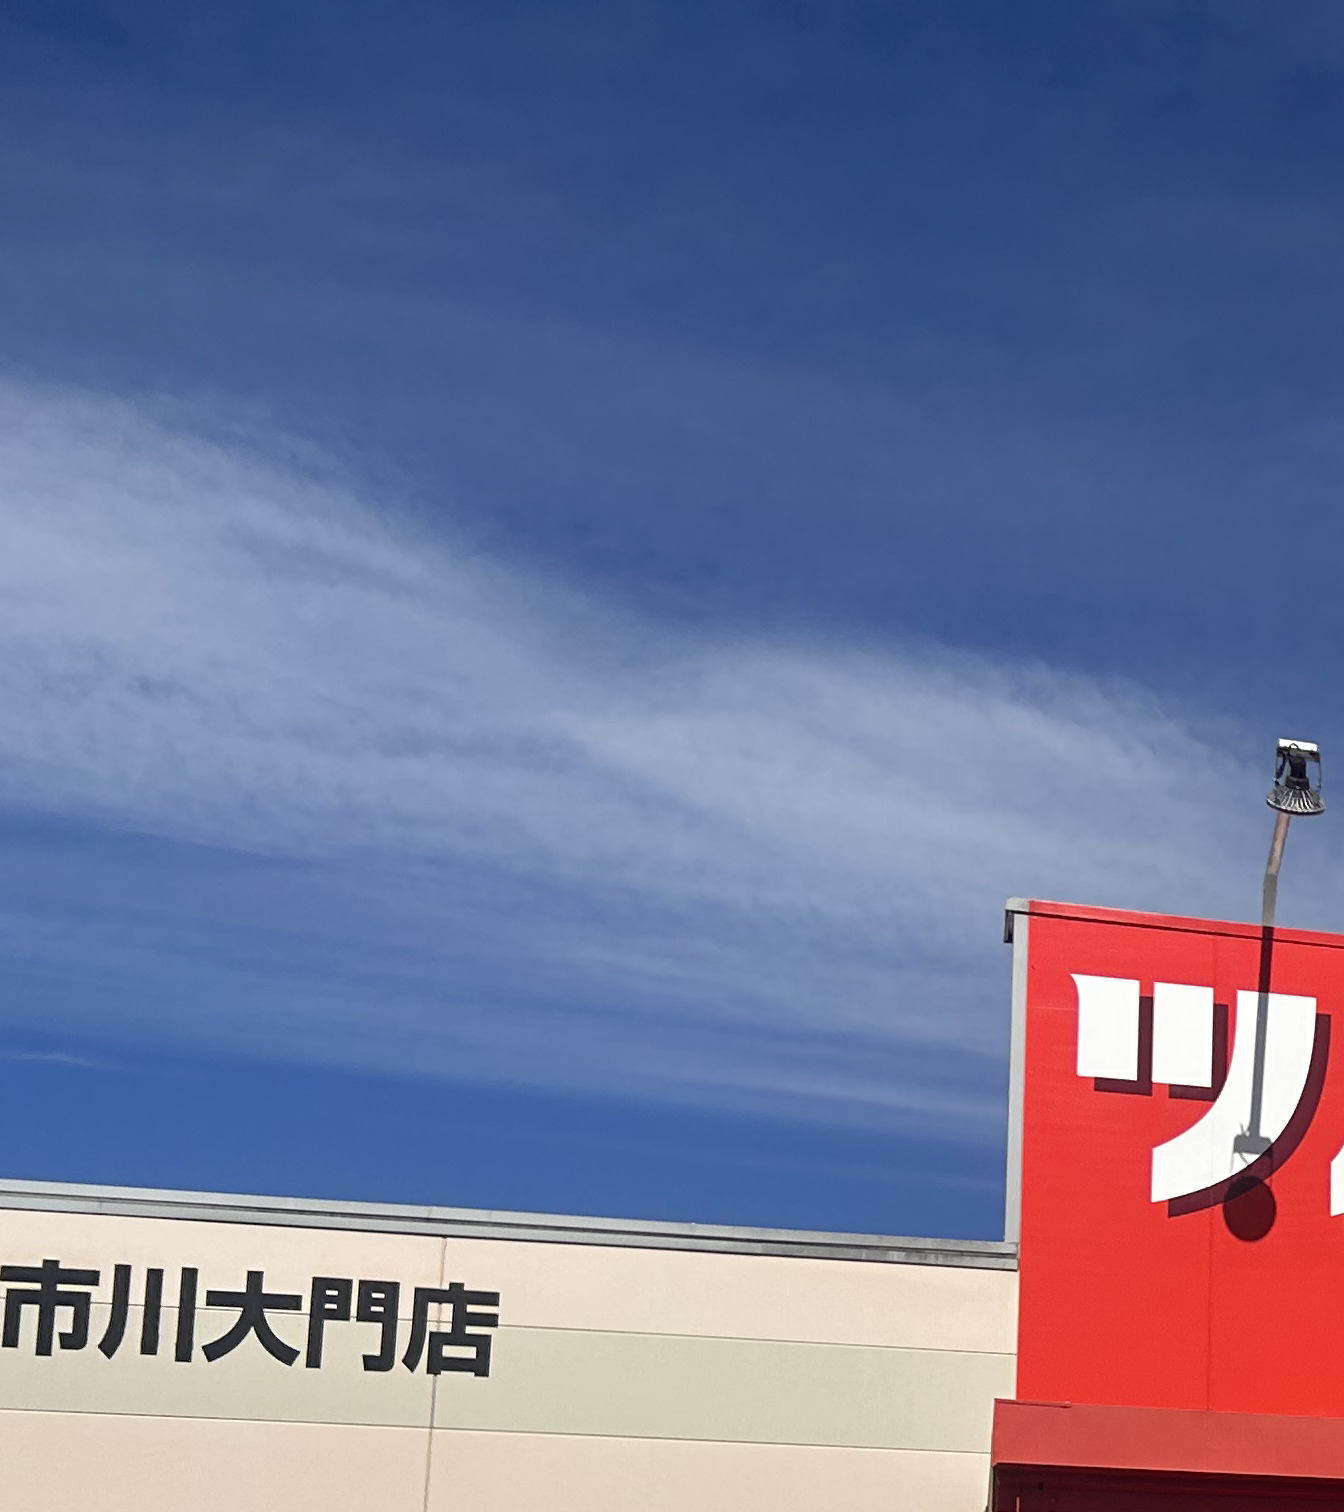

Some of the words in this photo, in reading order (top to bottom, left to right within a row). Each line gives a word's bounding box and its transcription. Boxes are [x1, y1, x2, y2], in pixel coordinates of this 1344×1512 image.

[0, 1259, 500, 1378] 市川大門店
